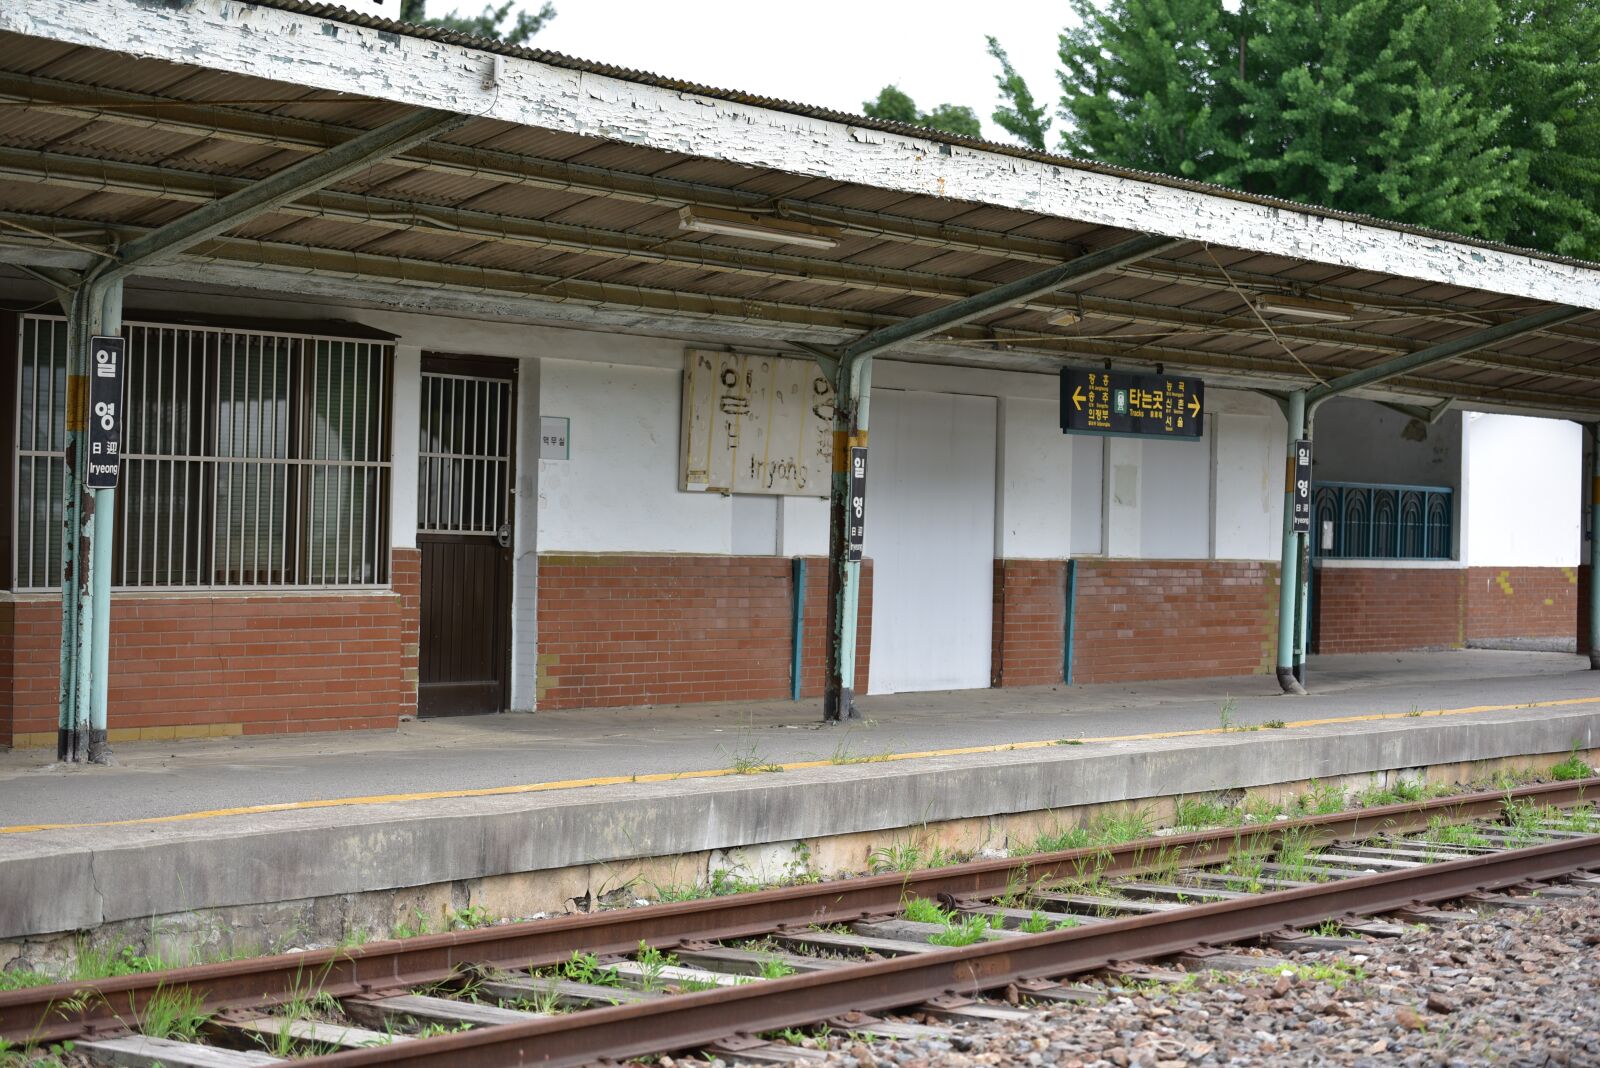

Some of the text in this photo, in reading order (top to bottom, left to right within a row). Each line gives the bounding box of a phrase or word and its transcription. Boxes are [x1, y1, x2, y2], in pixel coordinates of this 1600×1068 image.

[1129, 389, 1163, 410] 타는곳
[1088, 409, 1109, 420] 의정부
[1130, 409, 1144, 417] Tracks
[90, 462, 118, 476] Iryeong
